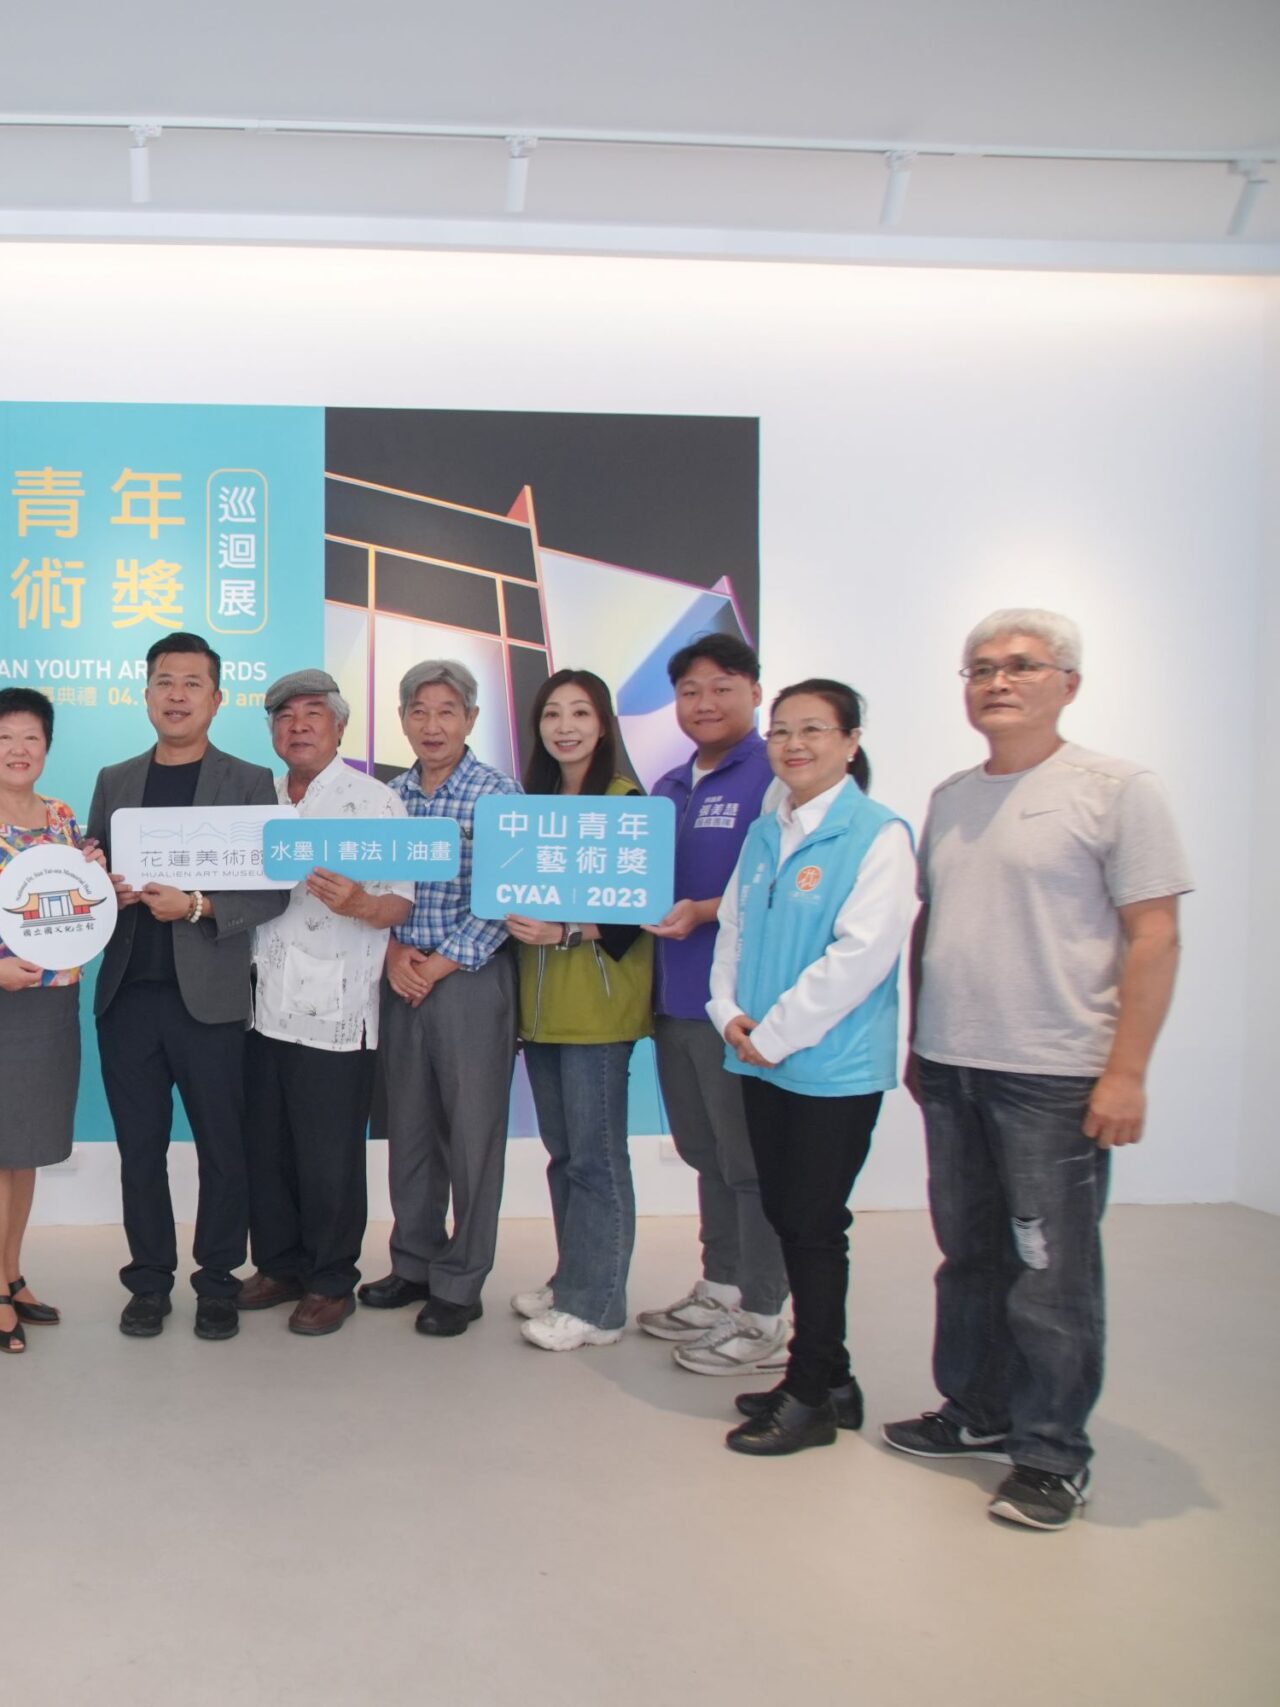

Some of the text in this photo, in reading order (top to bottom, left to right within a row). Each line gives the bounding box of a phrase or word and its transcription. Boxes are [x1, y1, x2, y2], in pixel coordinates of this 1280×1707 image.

[218, 485, 257, 617] 巡迴展
[35, 659, 112, 680] YOUTH
[118, 660, 148, 681] AR
[498, 810, 649, 841] 中山青年
[270, 840, 453, 862] 水墨 書法 油畫
[536, 845, 649, 875] 藝術獎
[496, 884, 648, 908] CYAA 2023
